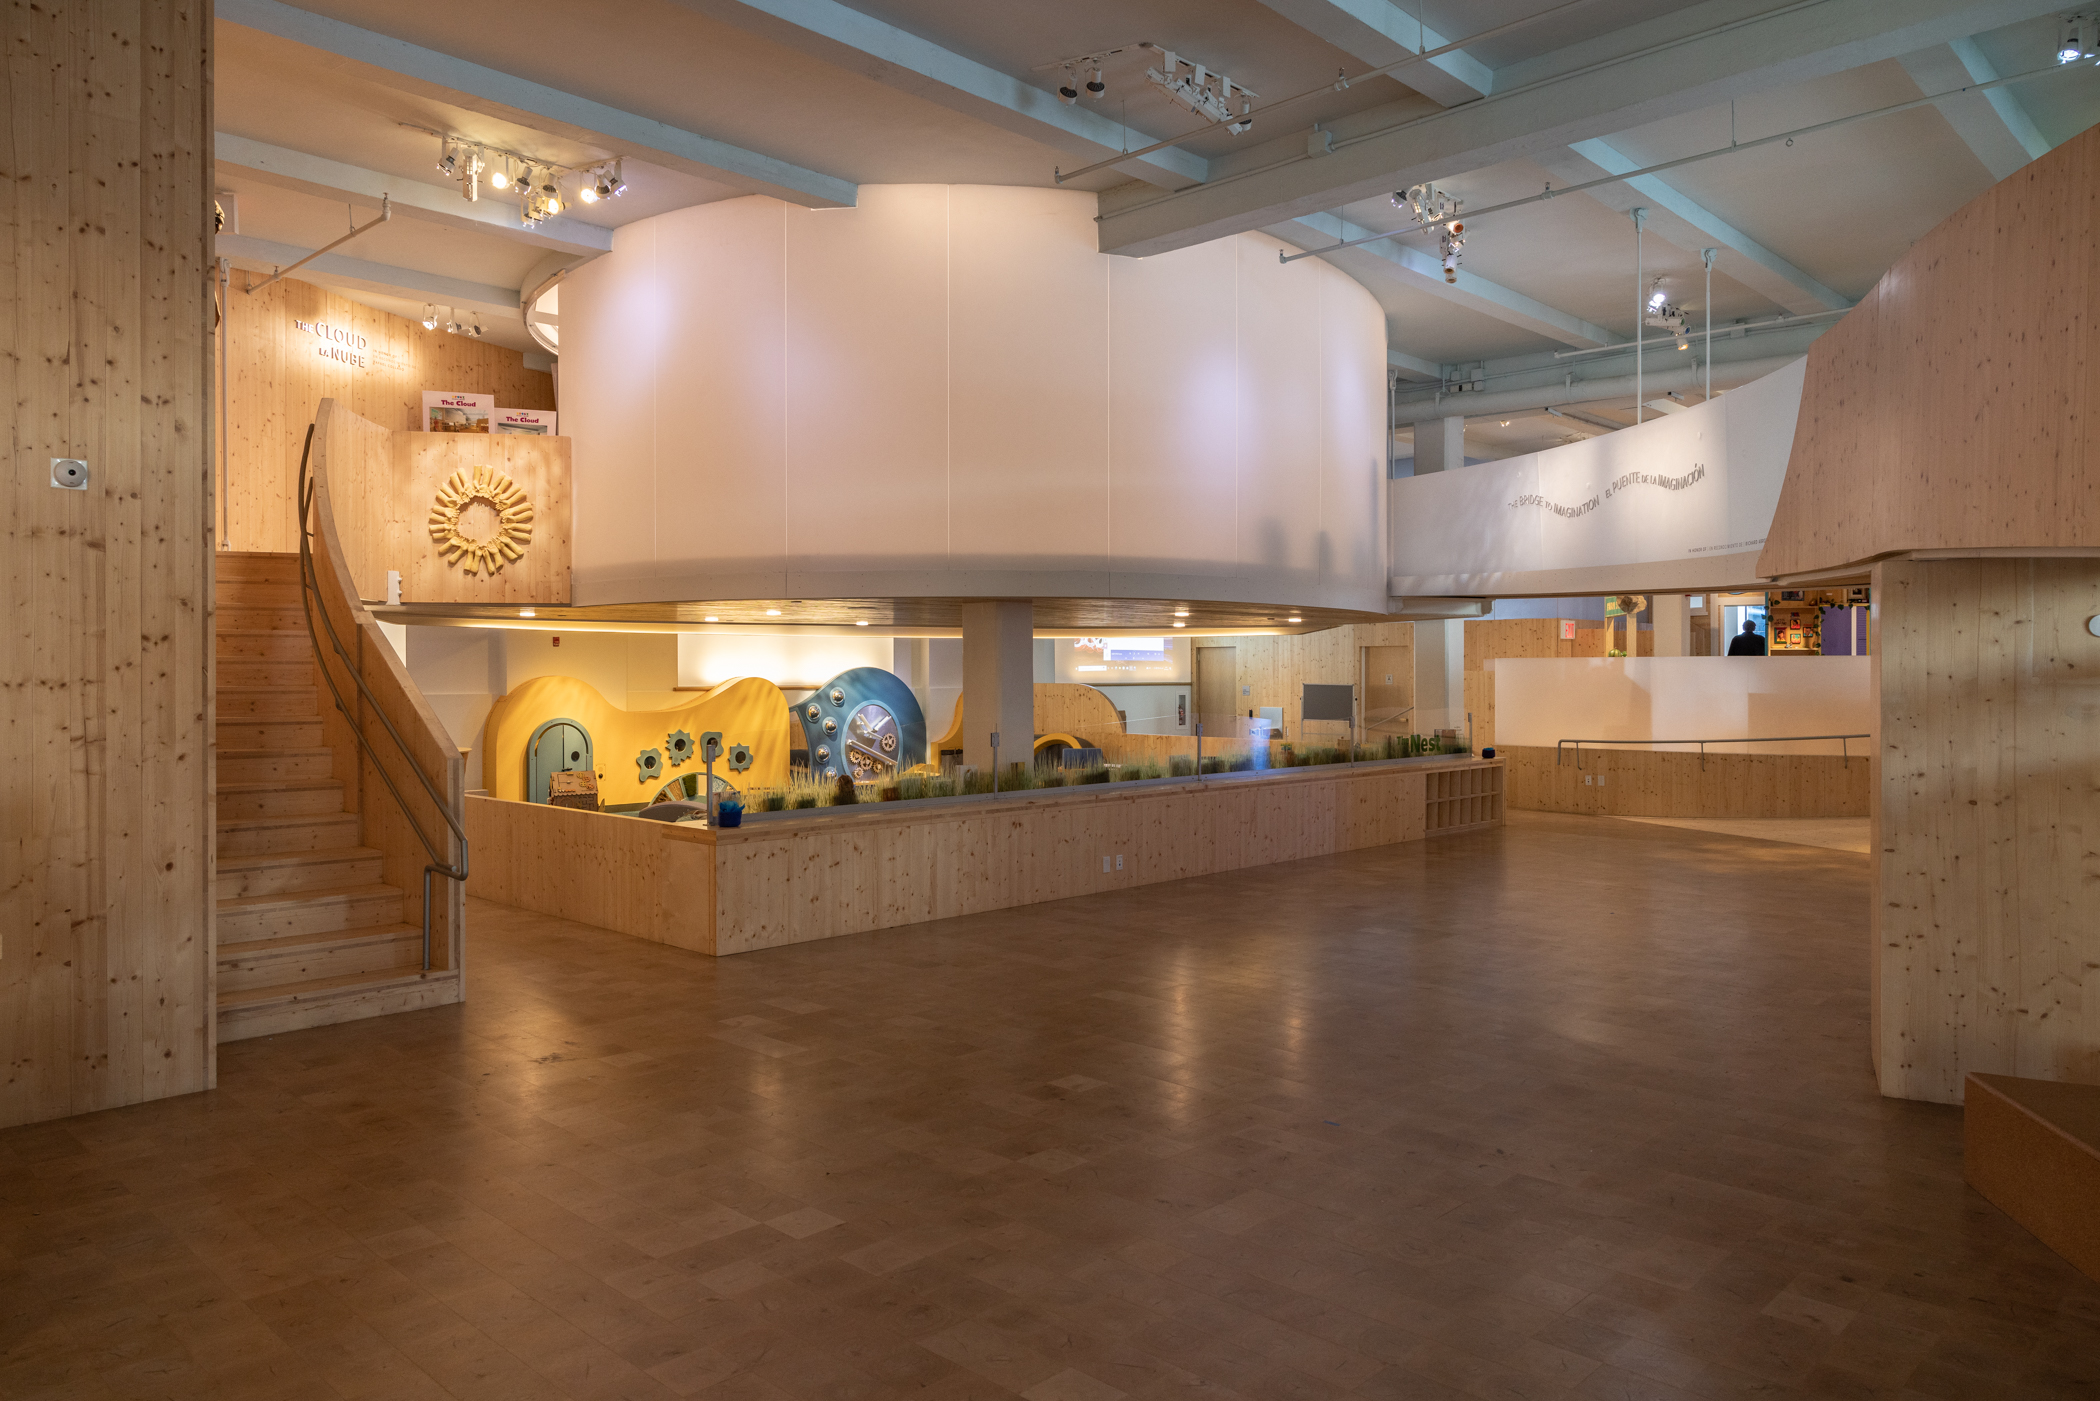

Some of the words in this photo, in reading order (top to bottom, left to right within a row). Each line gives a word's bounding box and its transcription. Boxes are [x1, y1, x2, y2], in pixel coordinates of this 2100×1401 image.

[294, 319, 314, 333] THE
[315, 322, 366, 350] CLOUD
[319, 347, 329, 357] LA
[331, 347, 365, 368] NUBE
[1605, 488, 1612, 498] EL
[1612, 471, 1640, 493] PUENTE
[1641, 475, 1649, 483] DE
[1650, 475, 1657, 485] LA
[1657, 463, 1705, 491] IMAGINACIÓN
[1508, 500, 1518, 510] THE
[1519, 495, 1544, 507] BRIDGE
[1545, 501, 1553, 510] TO
[1553, 494, 1600, 518] IMAGINATION
[1565, 623, 1574, 638] EXIT
[1410, 734, 1441, 752] Nest
